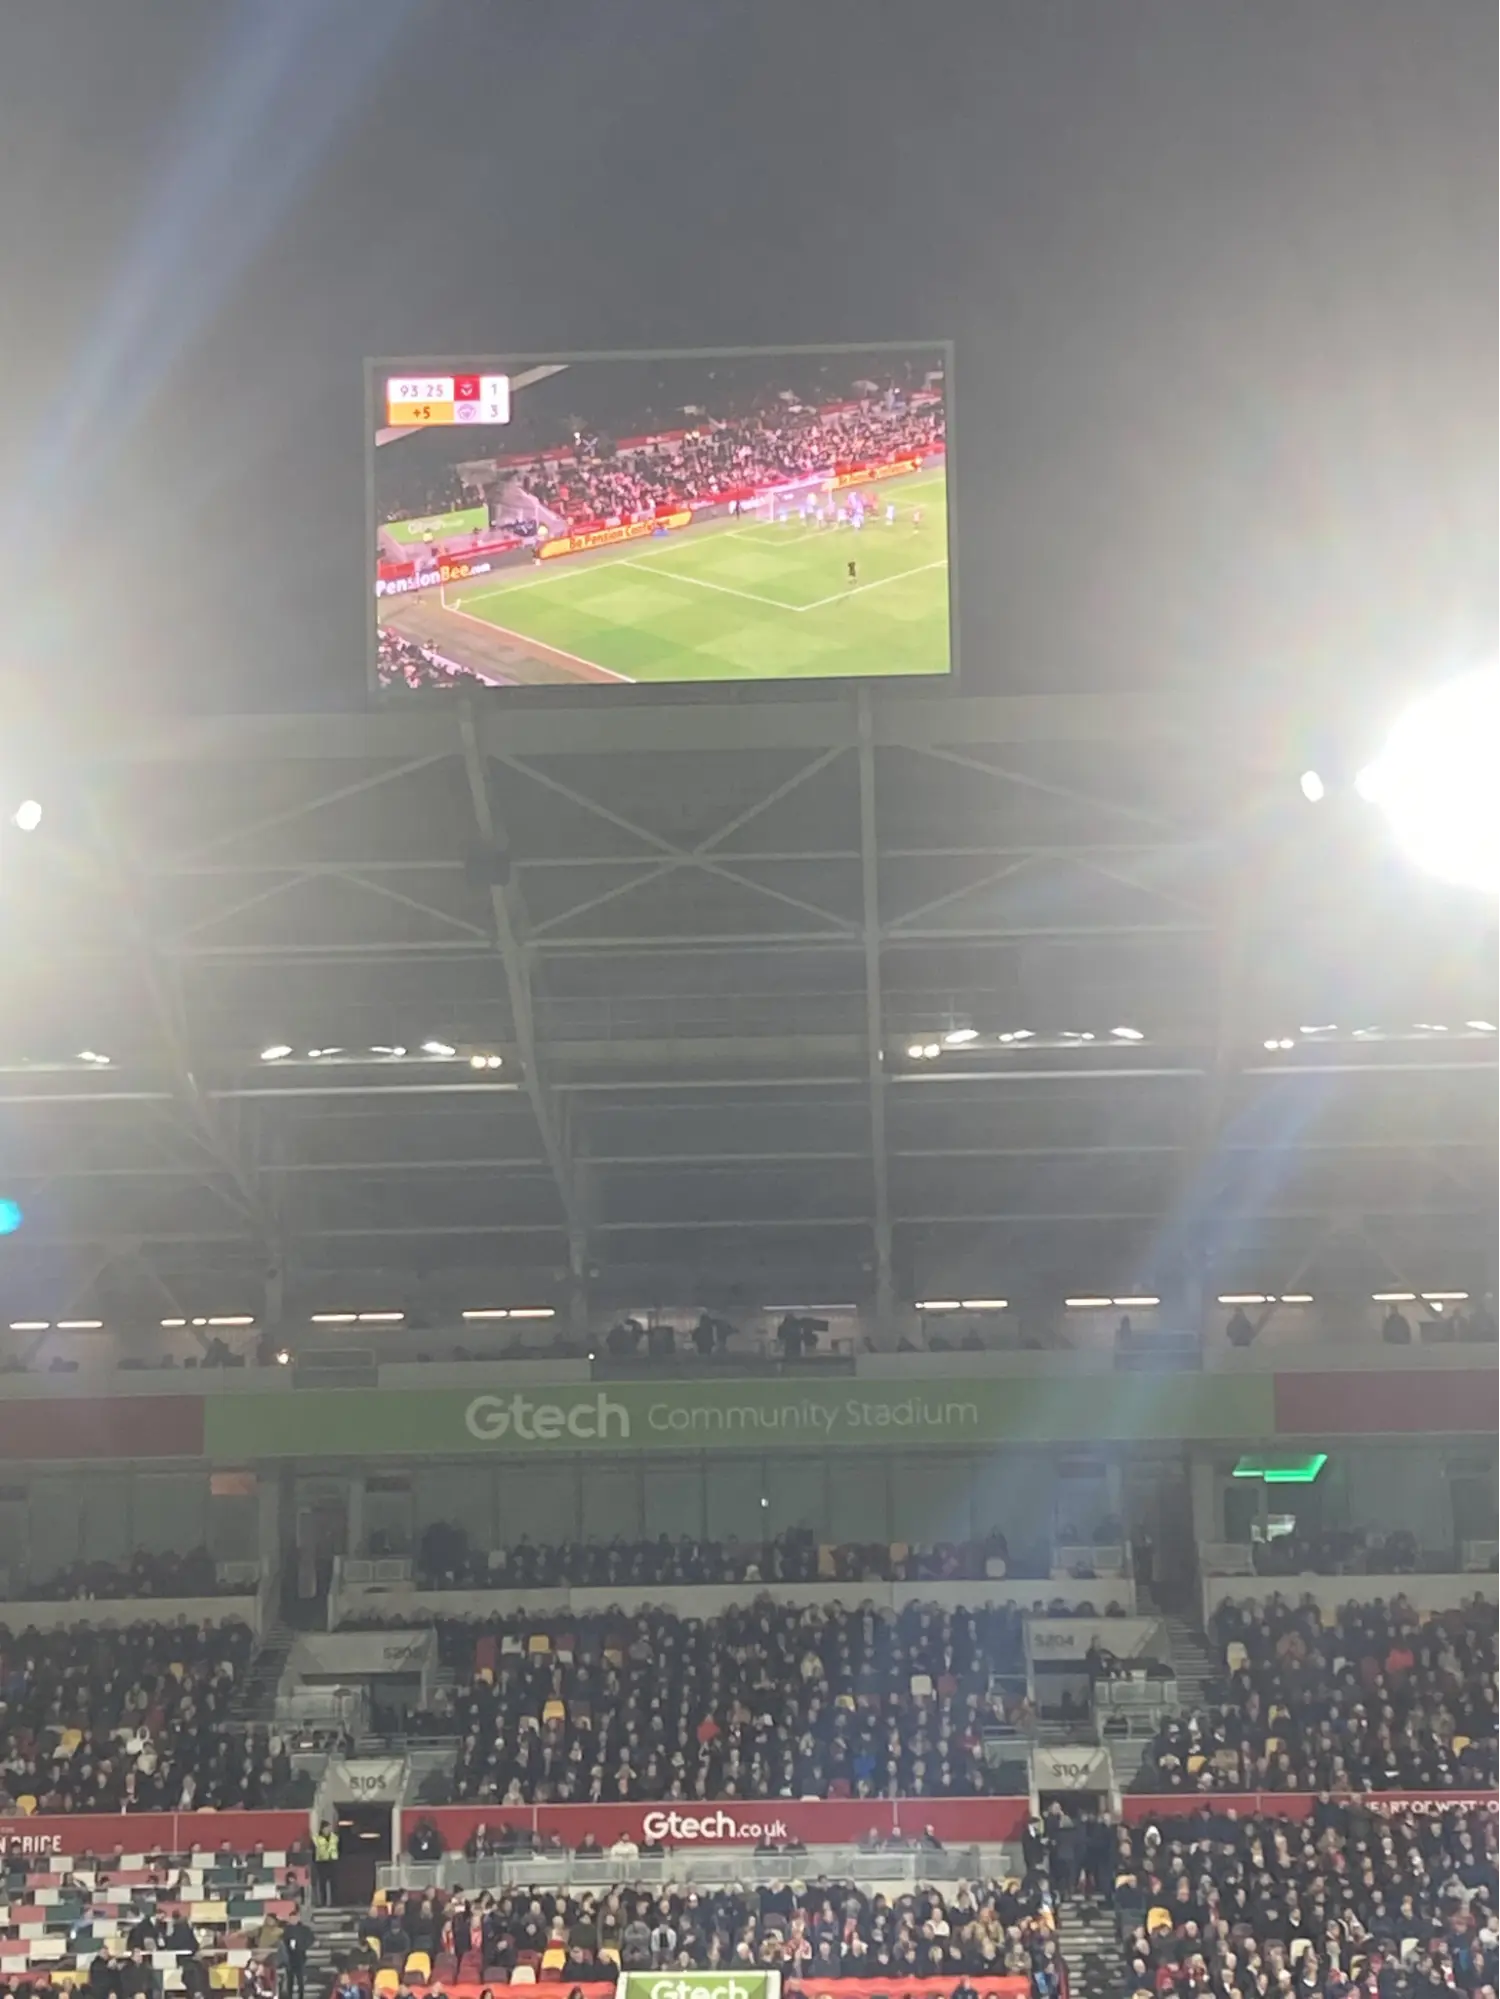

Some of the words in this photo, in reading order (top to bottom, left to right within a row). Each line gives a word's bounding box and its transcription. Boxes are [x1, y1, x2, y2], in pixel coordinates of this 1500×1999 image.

[400, 384, 419, 398] 93
[427, 384, 444, 398] 25
[490, 383, 498, 396] 1
[413, 405, 431, 420] +5
[490, 404, 499, 418] 3
[465, 1392, 630, 1440] Gtech
[648, 1400, 839, 1435] Community
[846, 1398, 978, 1427] Stadium
